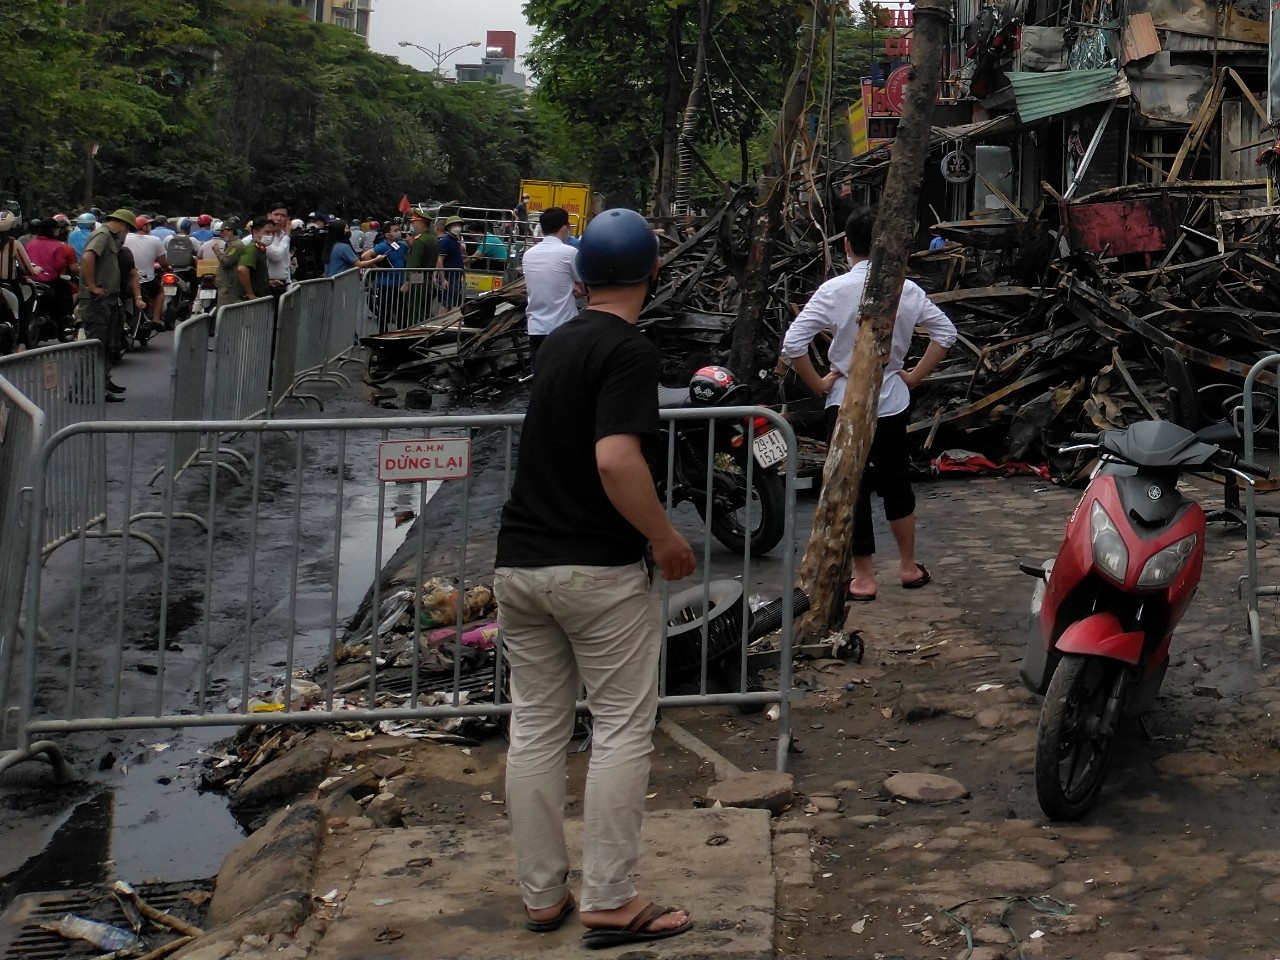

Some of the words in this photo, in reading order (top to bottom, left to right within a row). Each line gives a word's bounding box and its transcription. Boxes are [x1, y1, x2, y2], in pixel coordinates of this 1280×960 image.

[755, 432, 780, 453] 29-A1
[385, 454, 431, 471] DỪNG
[434, 456, 463, 471] LẠI
